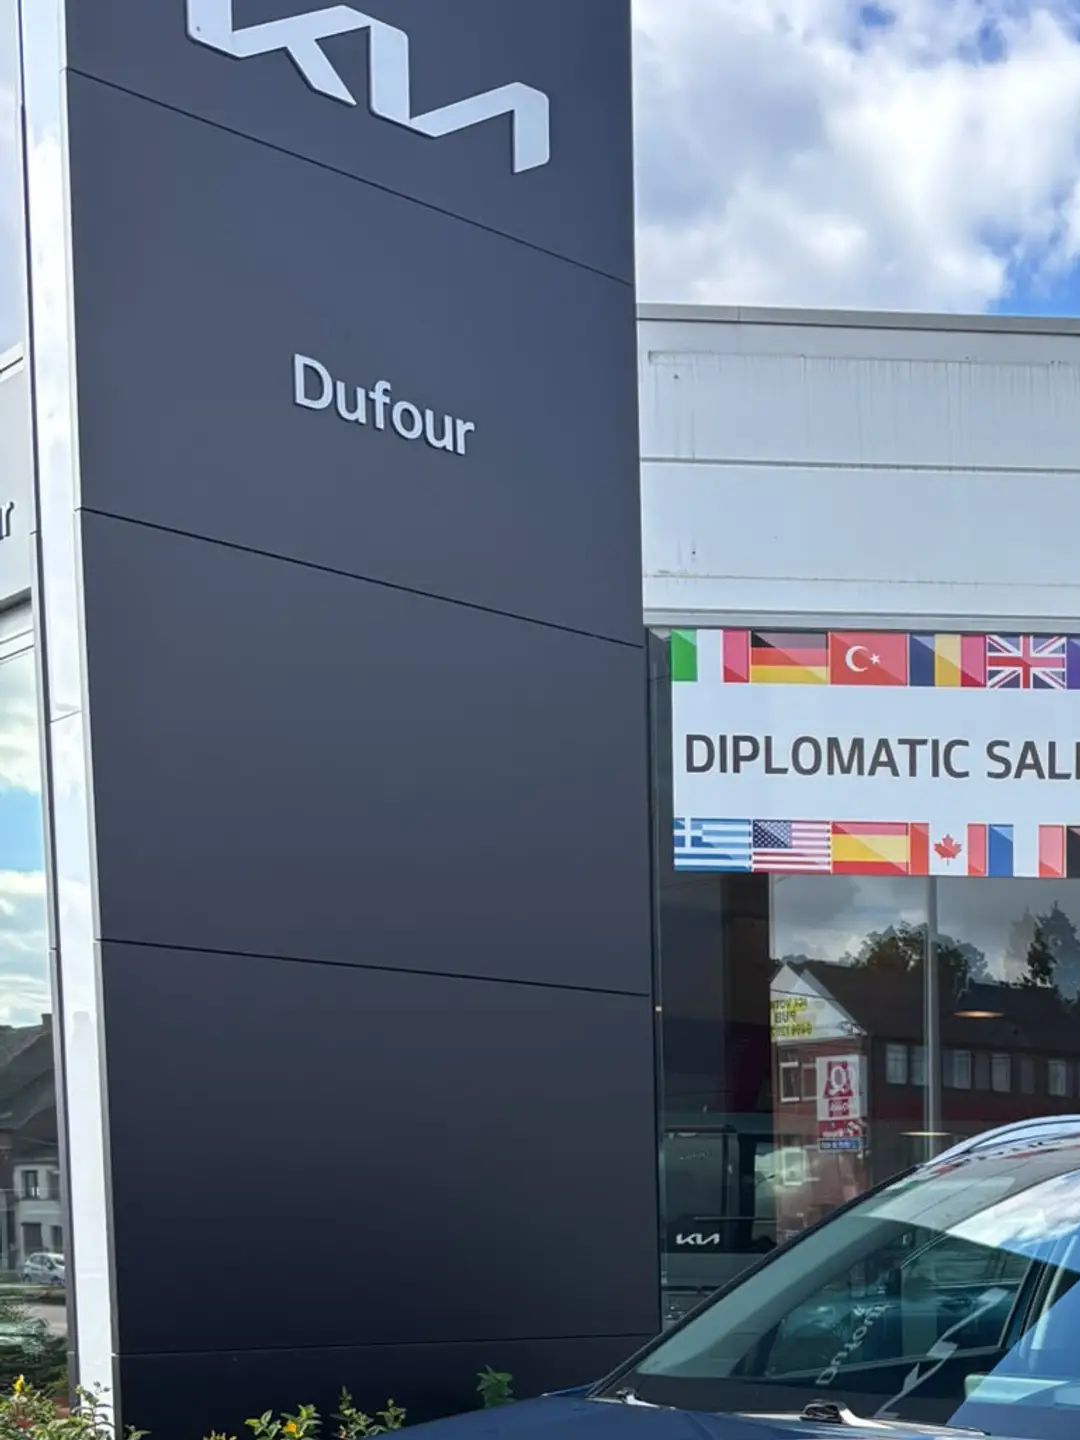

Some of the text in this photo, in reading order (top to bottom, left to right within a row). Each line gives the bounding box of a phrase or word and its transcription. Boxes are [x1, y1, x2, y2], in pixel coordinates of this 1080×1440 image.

[186, 0, 550, 174] KIA
[293, 352, 476, 456] Dufour
[684, 733, 971, 779] DIPLOMATIC
[676, 1232, 720, 1246] KIA
